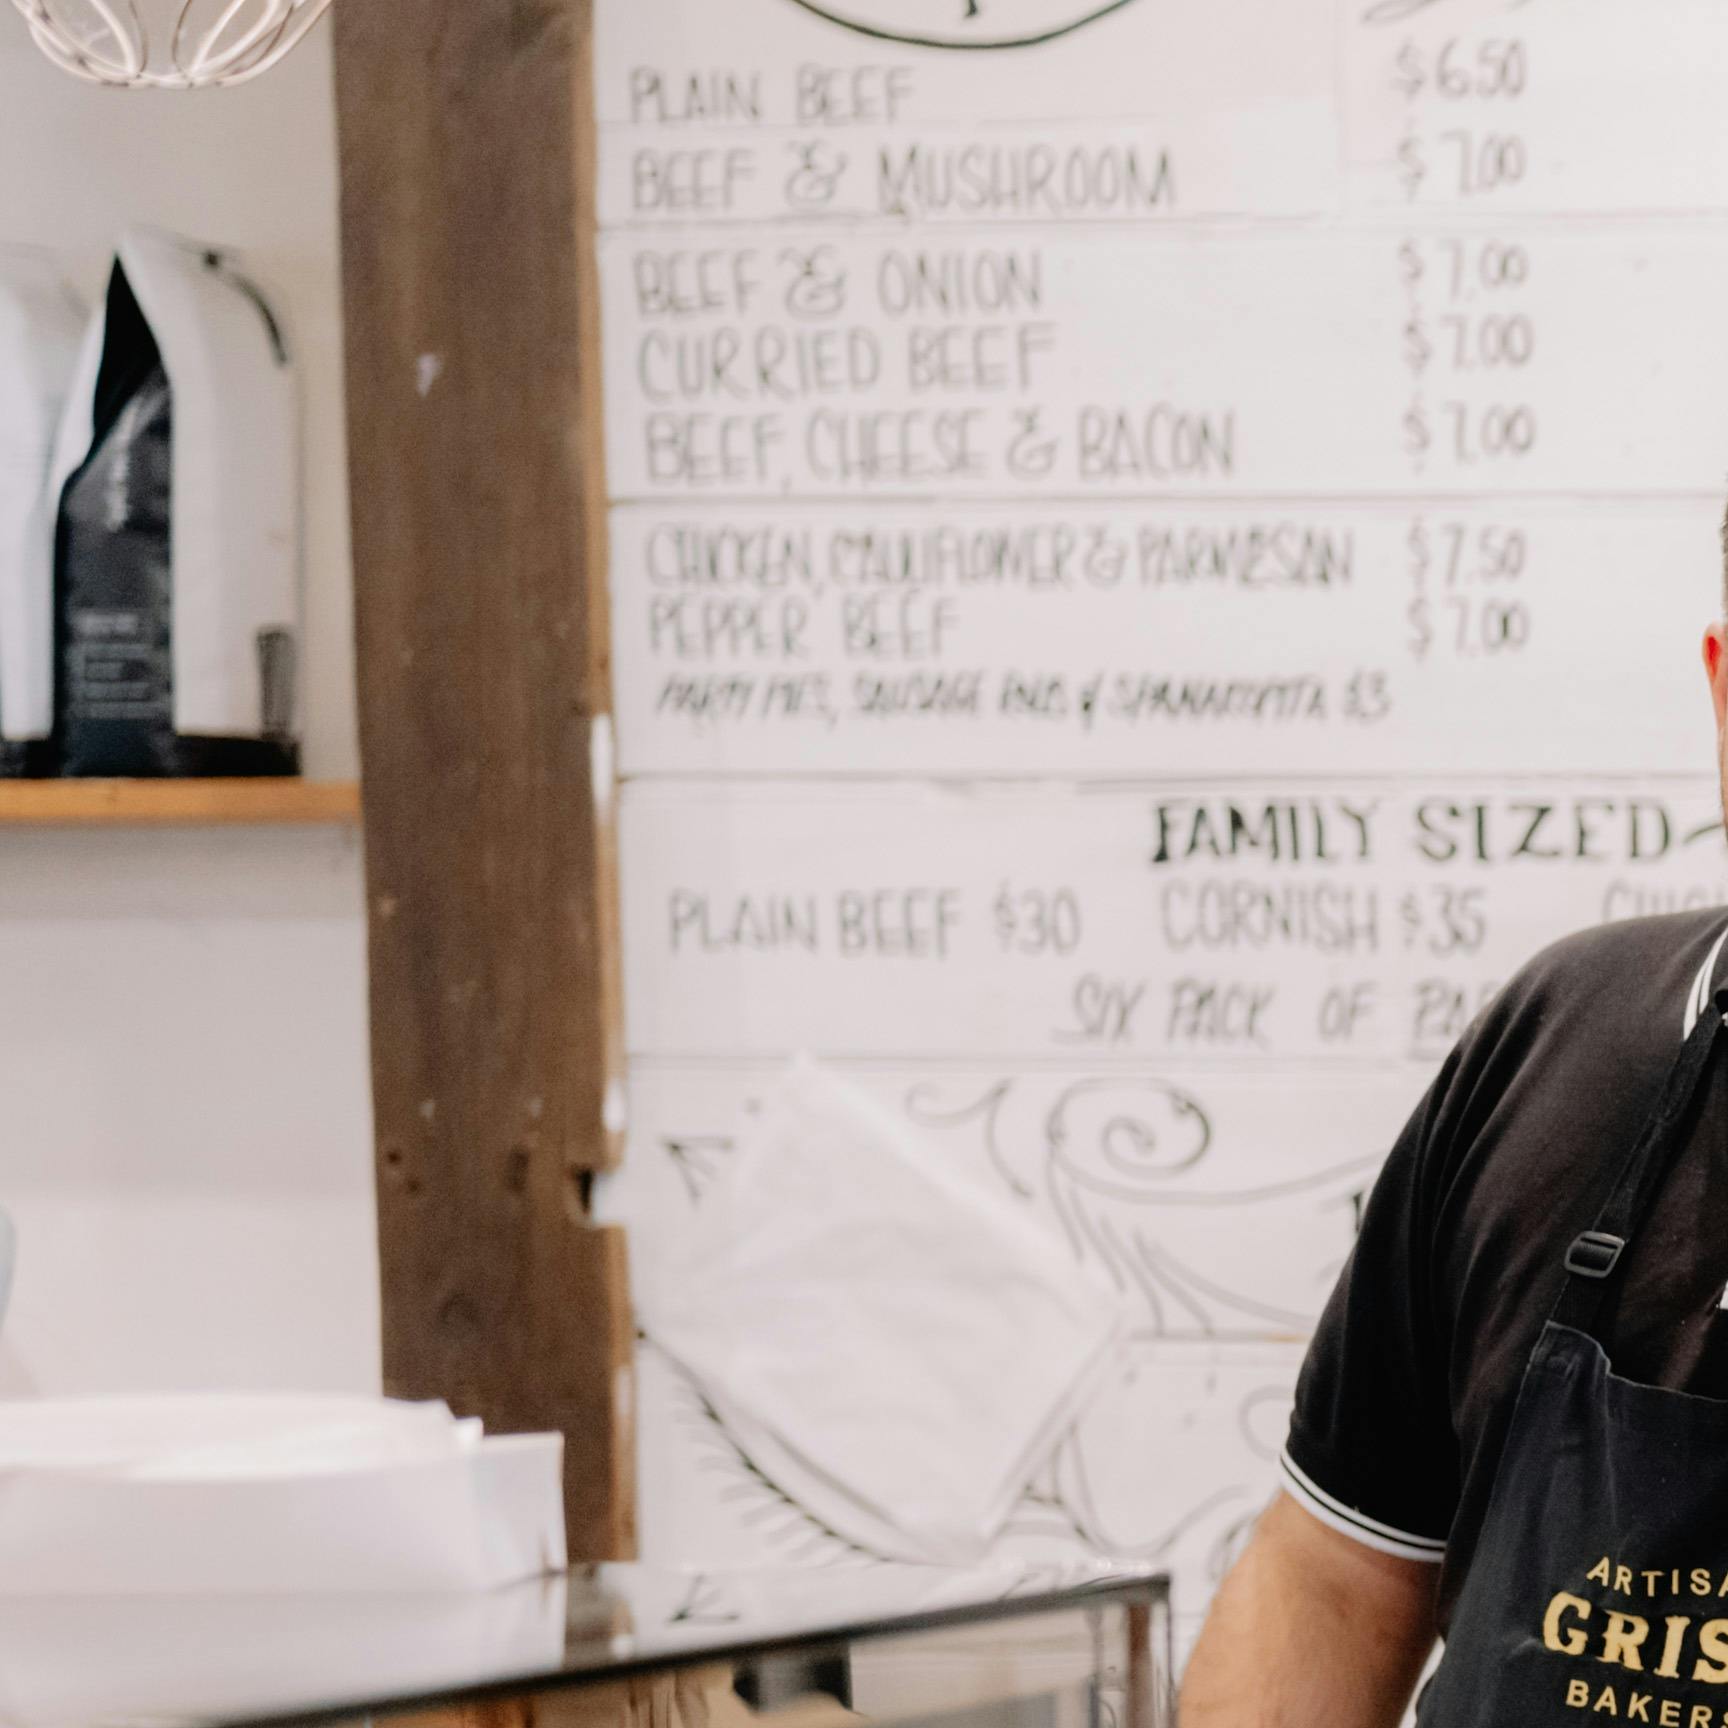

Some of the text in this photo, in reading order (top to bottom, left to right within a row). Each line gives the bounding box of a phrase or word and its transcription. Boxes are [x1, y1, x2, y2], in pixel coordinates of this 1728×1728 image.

[628, 65, 762, 124] PLAIN
[796, 63, 916, 126] BEEF
[632, 147, 757, 211] BEEF
[783, 138, 848, 204] &
[877, 143, 1177, 217] MUSHROOM
[632, 249, 762, 315] BEEF
[780, 245, 848, 319] &
[876, 251, 1043, 316] ONION
[637, 325, 882, 401] CURRIED
[908, 322, 1058, 393] BEEF
[805, 406, 992, 482] CHEESE
[1005, 409, 1061, 482] &
[1077, 406, 1238, 482] BACON
[648, 597, 807, 660] PEPPER
[841, 594, 961, 660] BEEF
[1152, 797, 1673, 864] FAMILY SIZED
[667, 876, 1488, 959] PLAIN BEEF $30 CORNISH $35
[1165, 975, 1278, 1047] PACK
[1317, 978, 1384, 1042] OF
